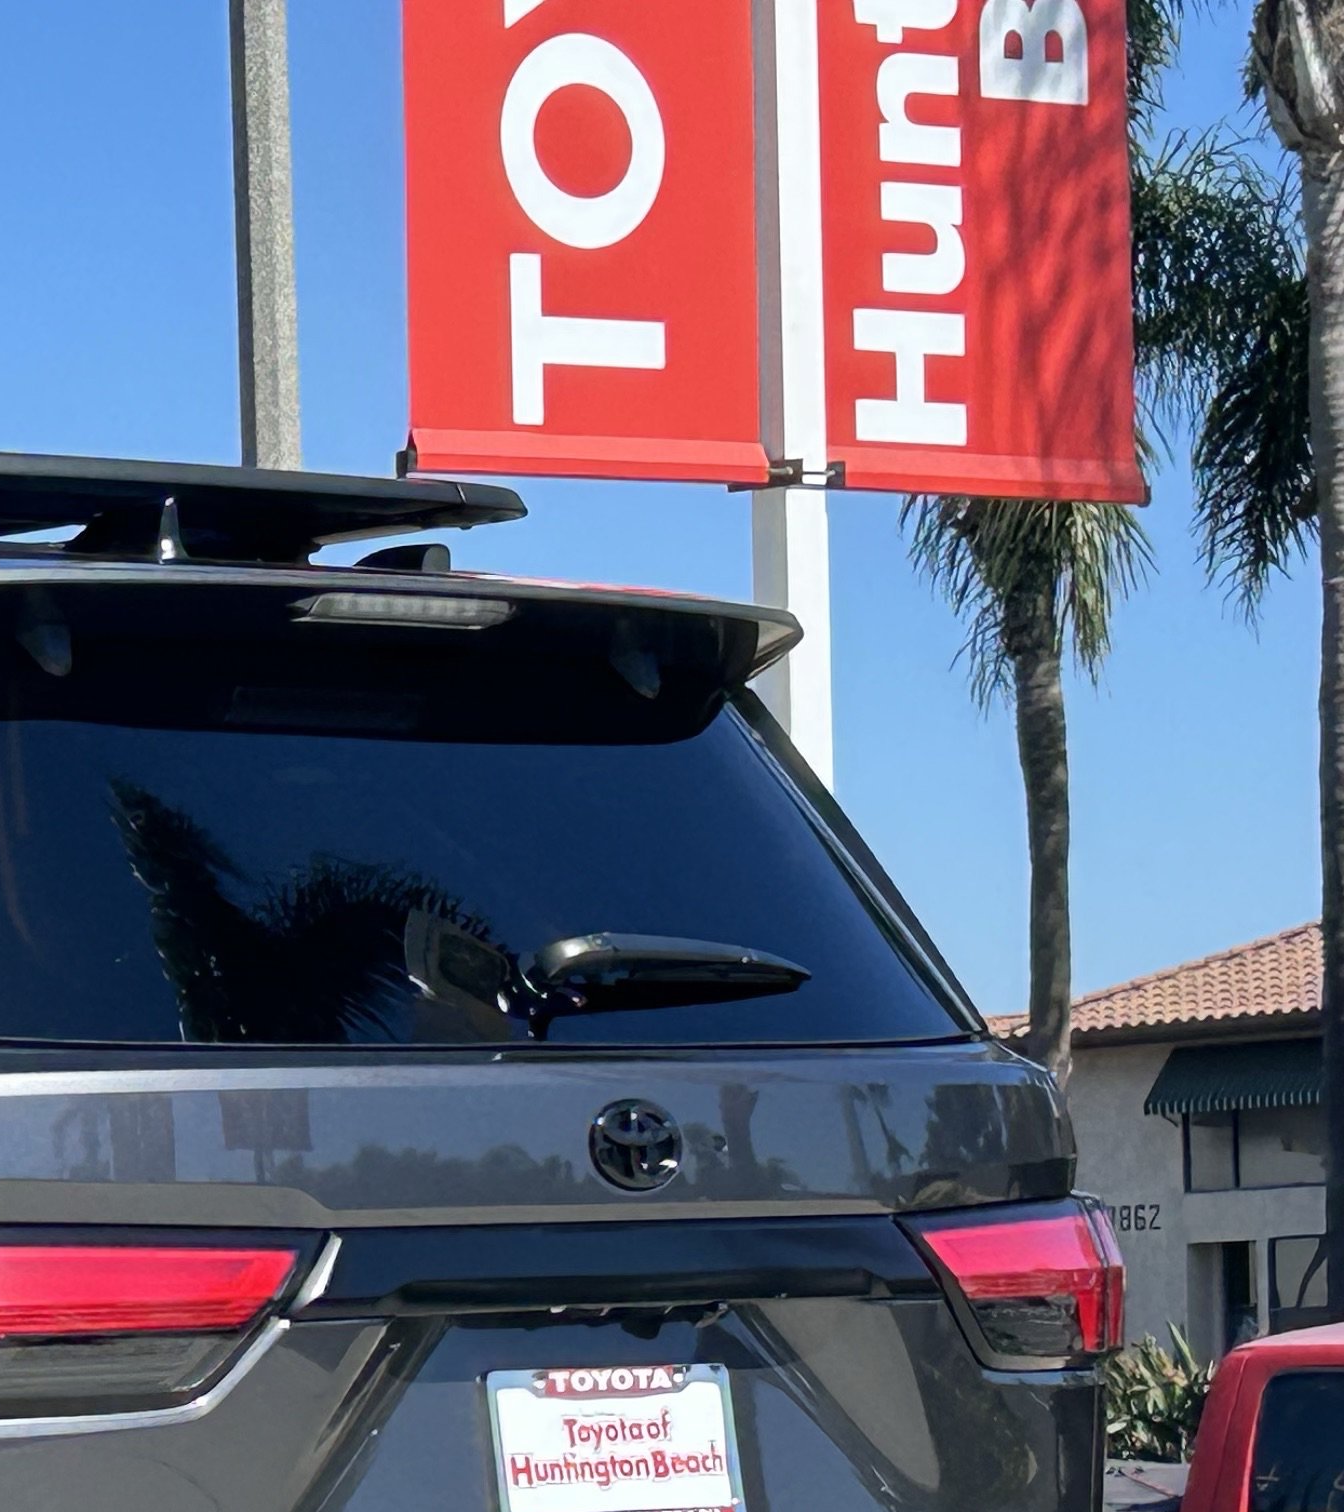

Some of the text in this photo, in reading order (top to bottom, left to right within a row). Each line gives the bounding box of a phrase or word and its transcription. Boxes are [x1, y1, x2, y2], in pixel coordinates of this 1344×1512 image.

[499, 0, 666, 426] TO
[548, 1366, 673, 1393] TOYOTA
[563, 1405, 672, 1451] Toyota of
[510, 1440, 724, 1487] Huntington Beach
